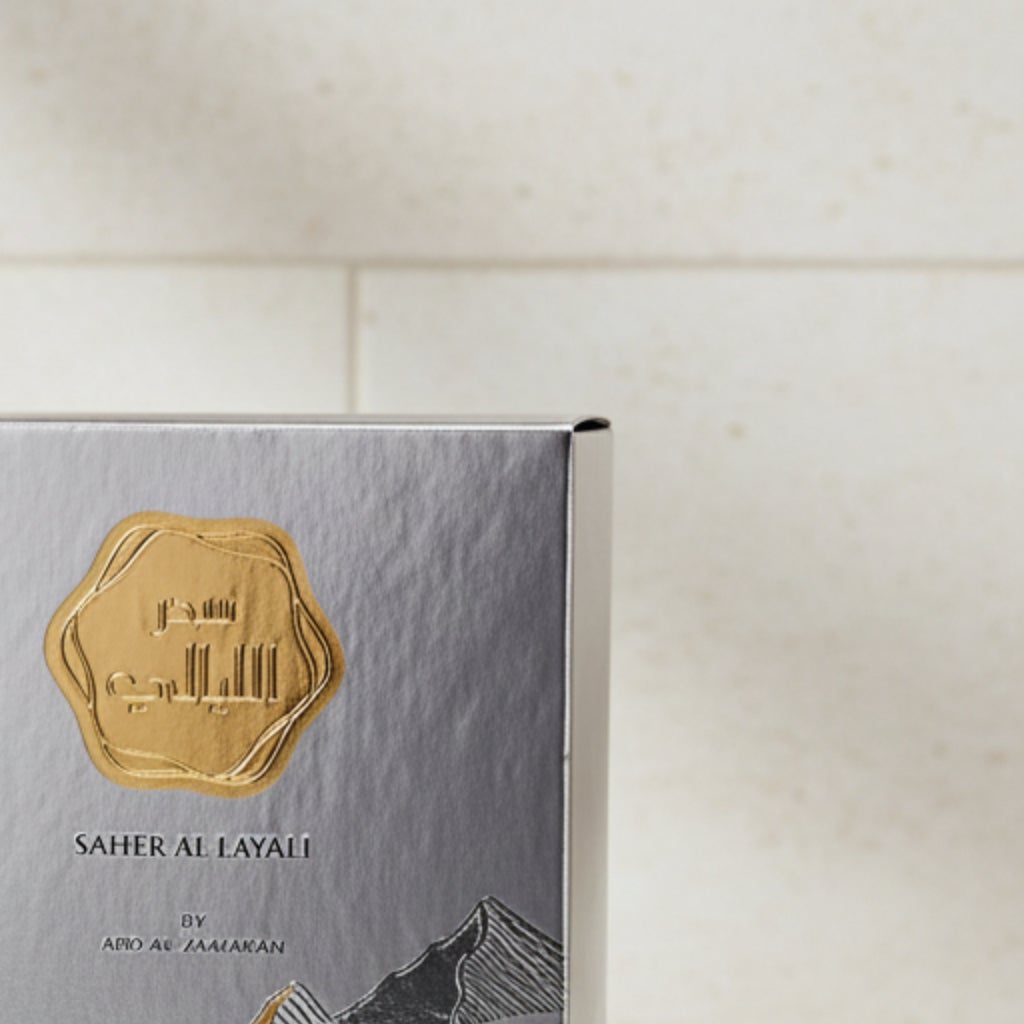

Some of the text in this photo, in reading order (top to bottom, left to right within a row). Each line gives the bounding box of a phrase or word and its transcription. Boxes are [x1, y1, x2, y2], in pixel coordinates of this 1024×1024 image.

[74, 833, 310, 859] SAHER AL LAYALI
[181, 913, 207, 928] BY
